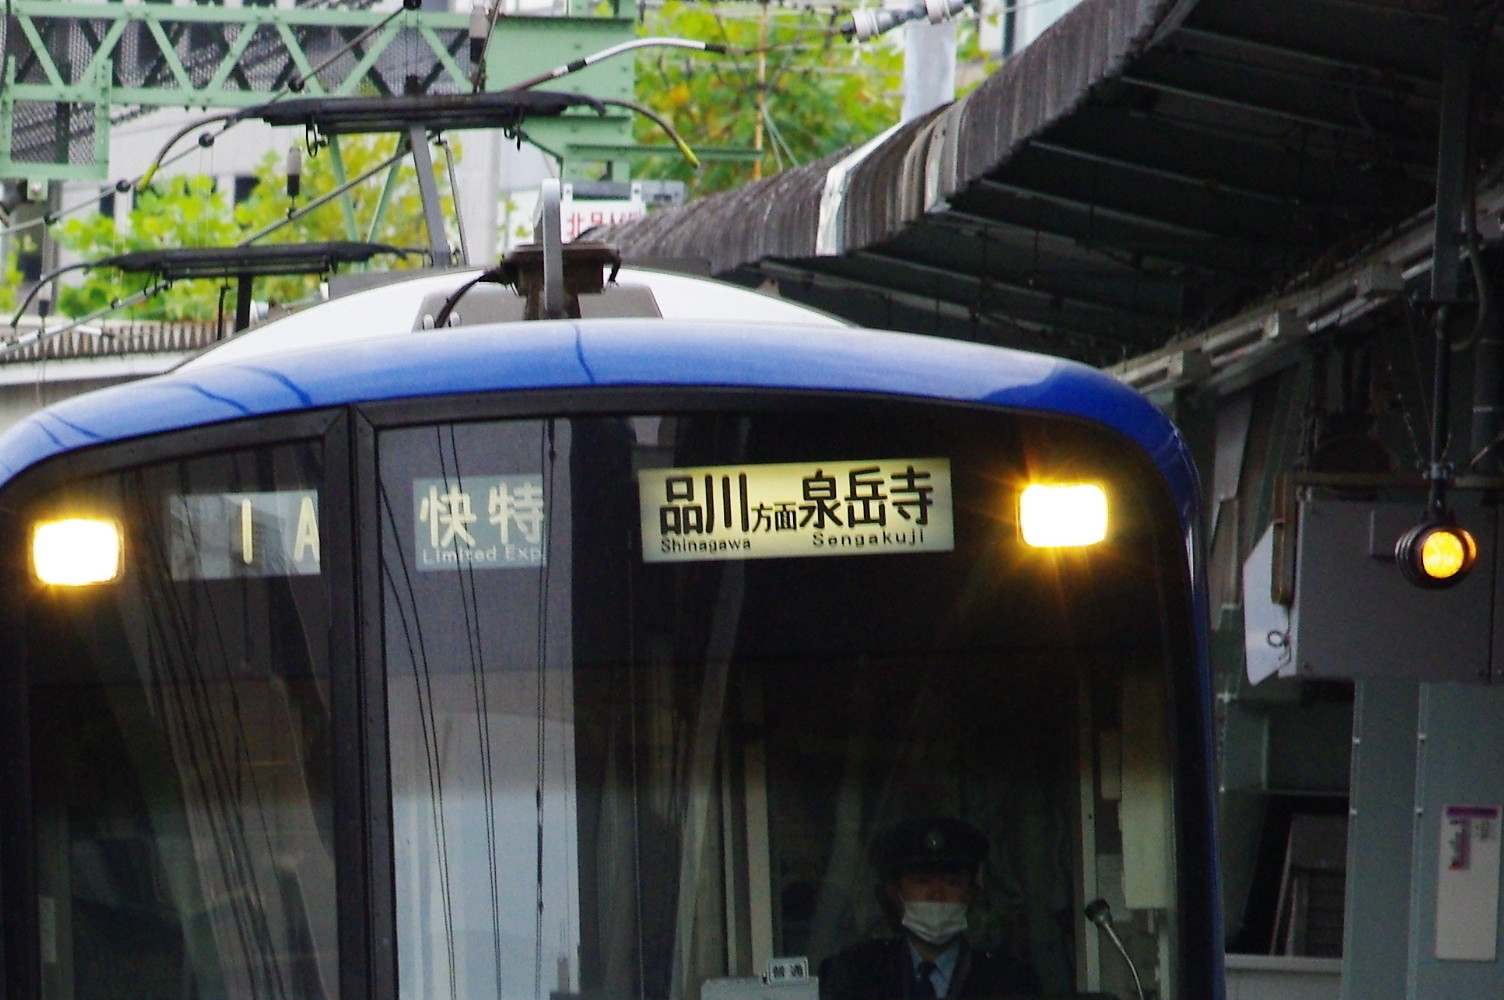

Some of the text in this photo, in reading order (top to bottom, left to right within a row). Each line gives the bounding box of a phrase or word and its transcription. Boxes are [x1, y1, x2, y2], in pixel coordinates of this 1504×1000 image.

[419, 482, 544, 548] 快特
[661, 530, 924, 553] Shinagawa Sengakuji
[423, 545, 497, 564] Limited
